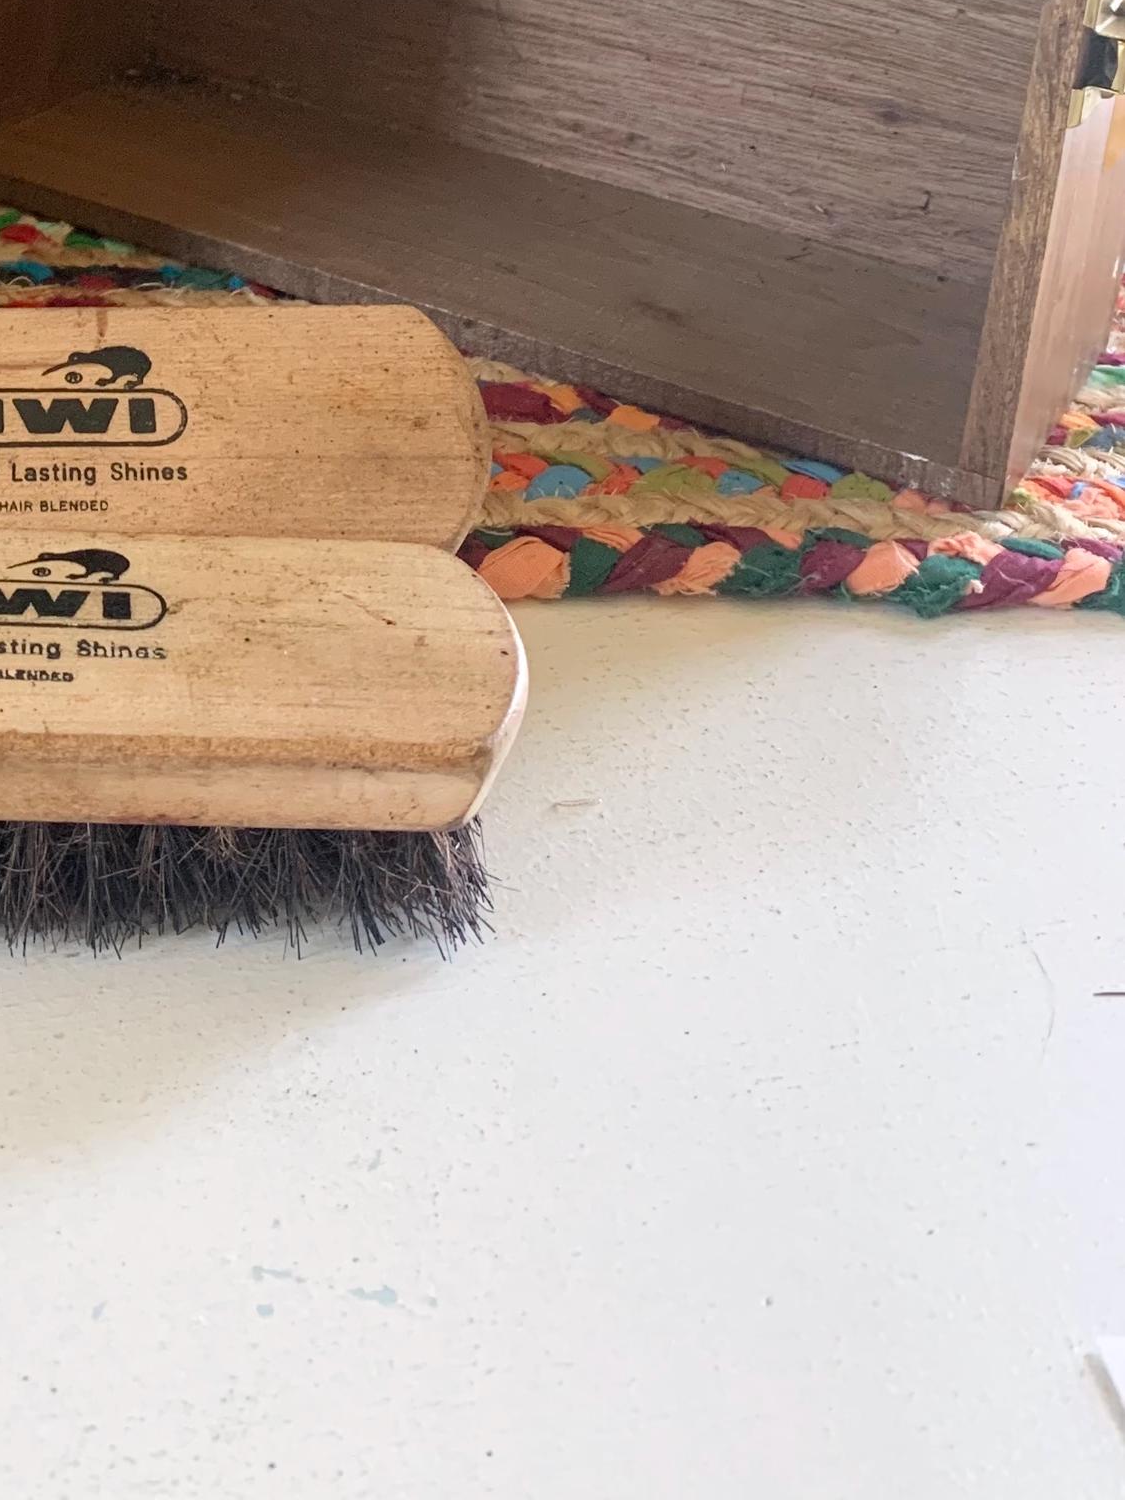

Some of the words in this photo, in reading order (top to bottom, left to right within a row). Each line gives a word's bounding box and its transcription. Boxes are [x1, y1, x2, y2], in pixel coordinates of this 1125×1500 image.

[11, 463, 97, 486] Lasting
[110, 462, 188, 482] Shines
[39, 500, 109, 512] BLENDED
[77, 640, 168, 660] Shines
